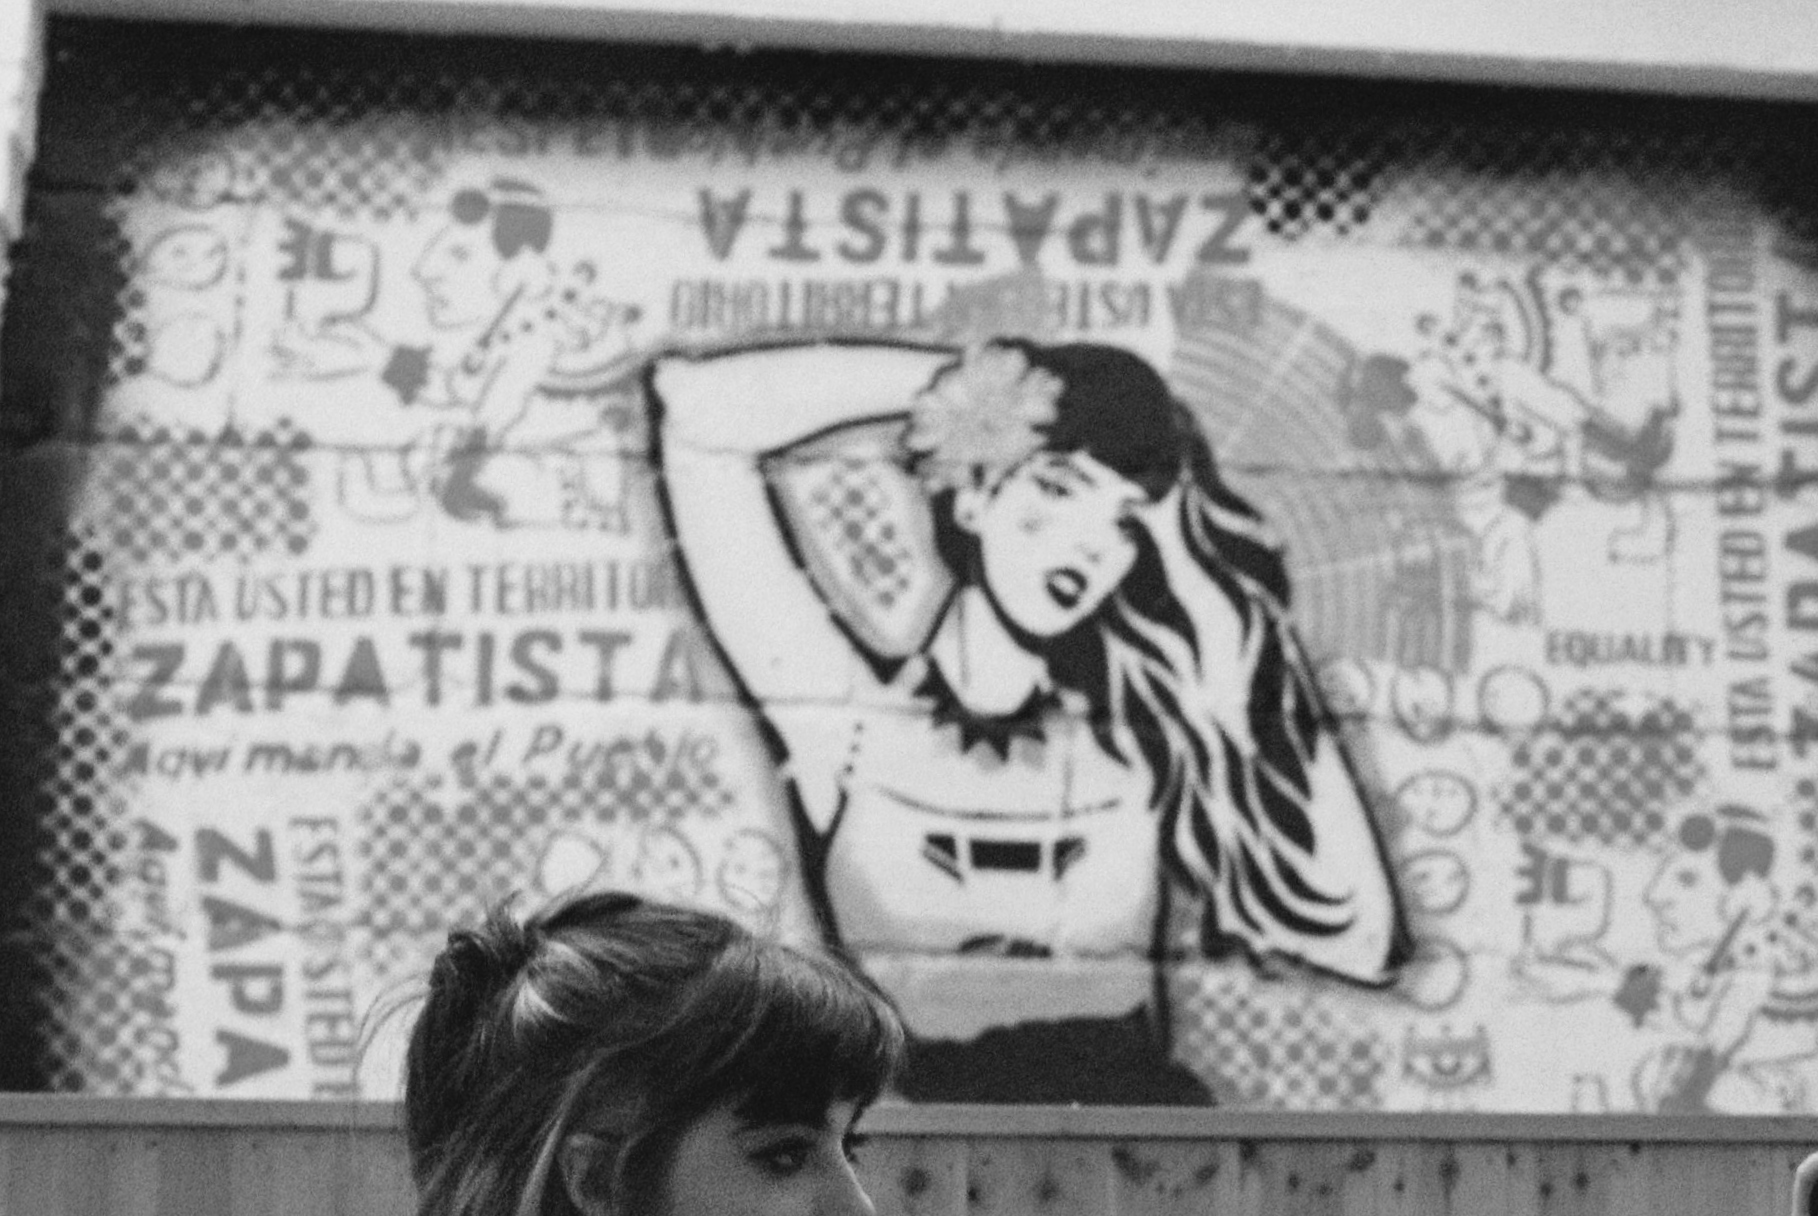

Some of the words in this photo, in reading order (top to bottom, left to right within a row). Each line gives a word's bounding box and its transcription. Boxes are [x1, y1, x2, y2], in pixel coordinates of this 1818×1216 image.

[696, 186, 1252, 265] ZAPATISTA
[1042, 277, 1152, 332] USTE
[236, 566, 376, 622] USTED
[388, 562, 449, 618] EN
[466, 557, 682, 616] TERRITO
[1718, 530, 1770, 662] USTED
[126, 626, 704, 722] ZAPATISTA
[1544, 628, 1716, 668] EQUALITY
[1728, 677, 1778, 771] ESTA
[194, 826, 291, 1090] ZAPA
